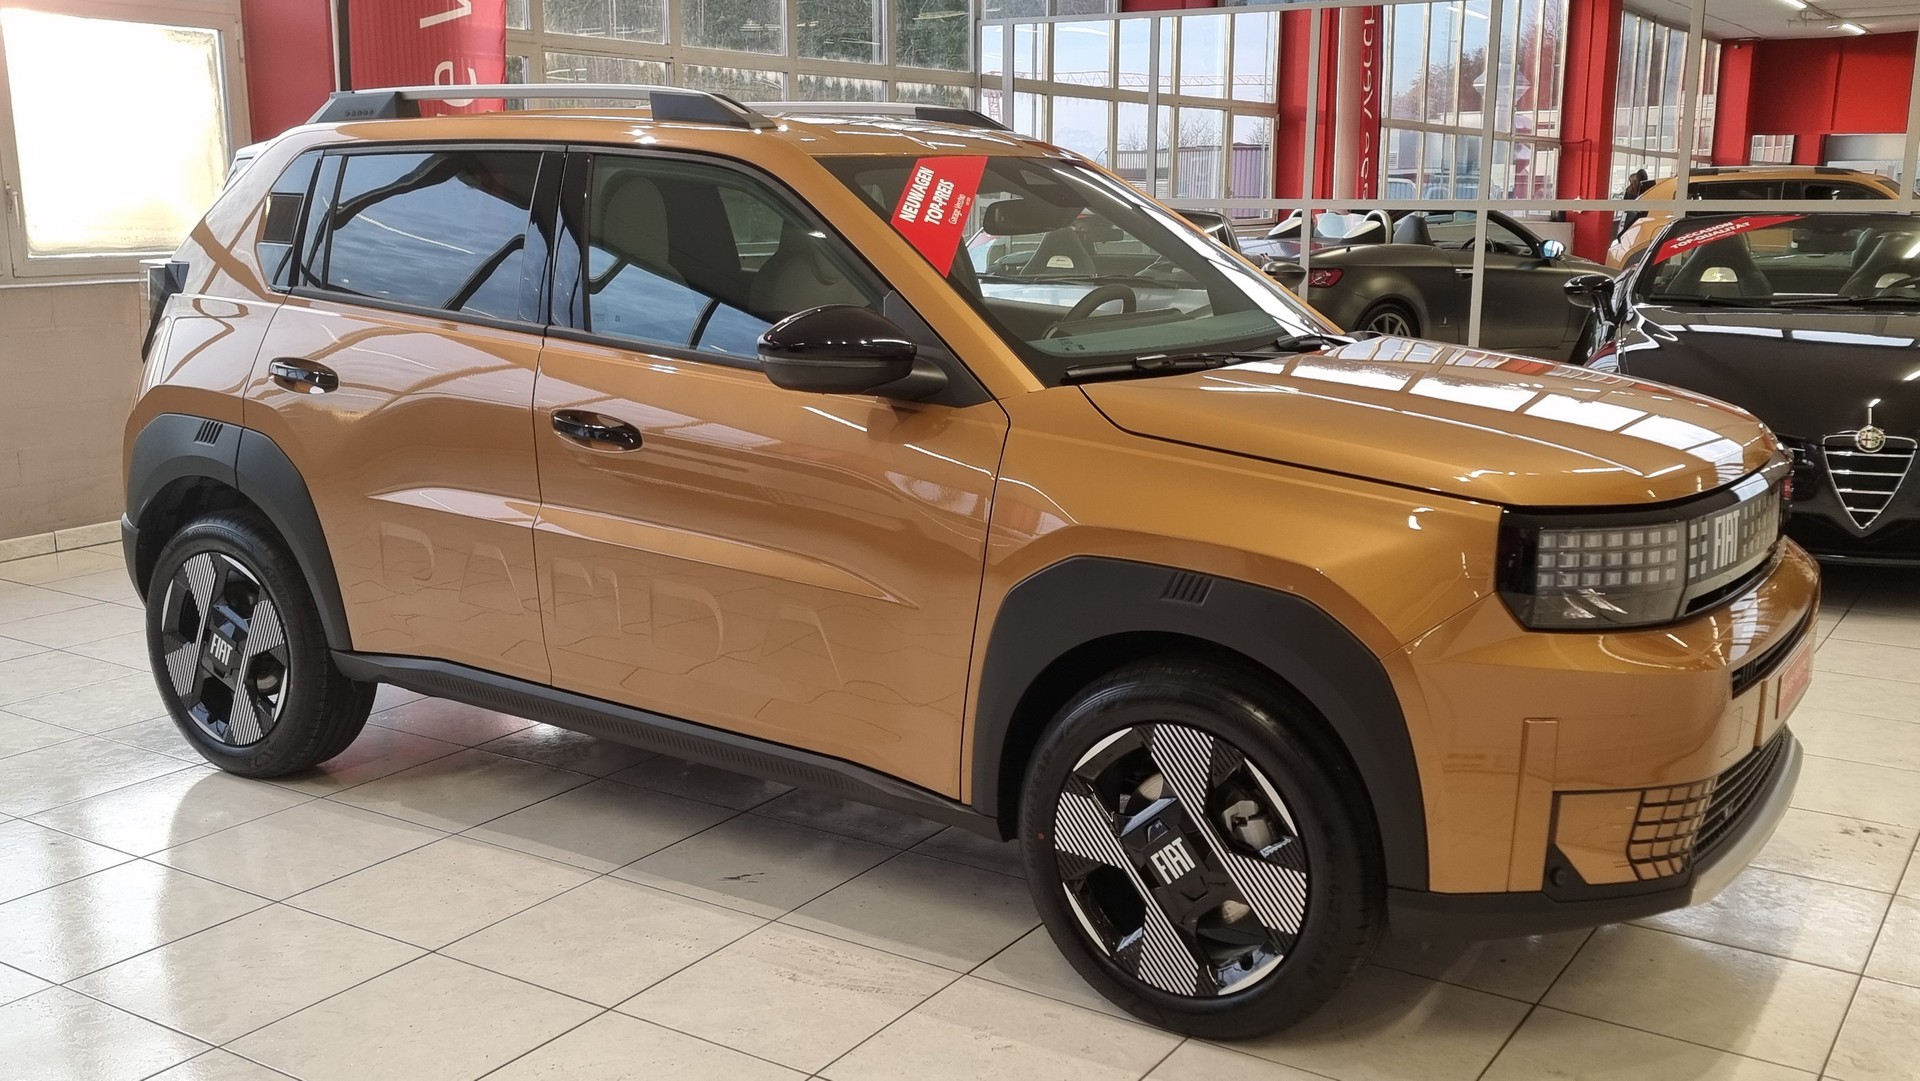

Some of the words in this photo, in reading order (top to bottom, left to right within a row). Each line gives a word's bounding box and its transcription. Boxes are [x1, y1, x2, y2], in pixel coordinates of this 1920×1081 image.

[899, 166, 934, 223] NEUWAGEN
[924, 178, 954, 225] TOP-PREIS
[1676, 221, 1734, 242] OCCASION
[1713, 509, 1740, 570] FIAT
[379, 521, 844, 687] PANDA
[210, 632, 233, 666] FIAT
[1150, 836, 1197, 885] FIAT
